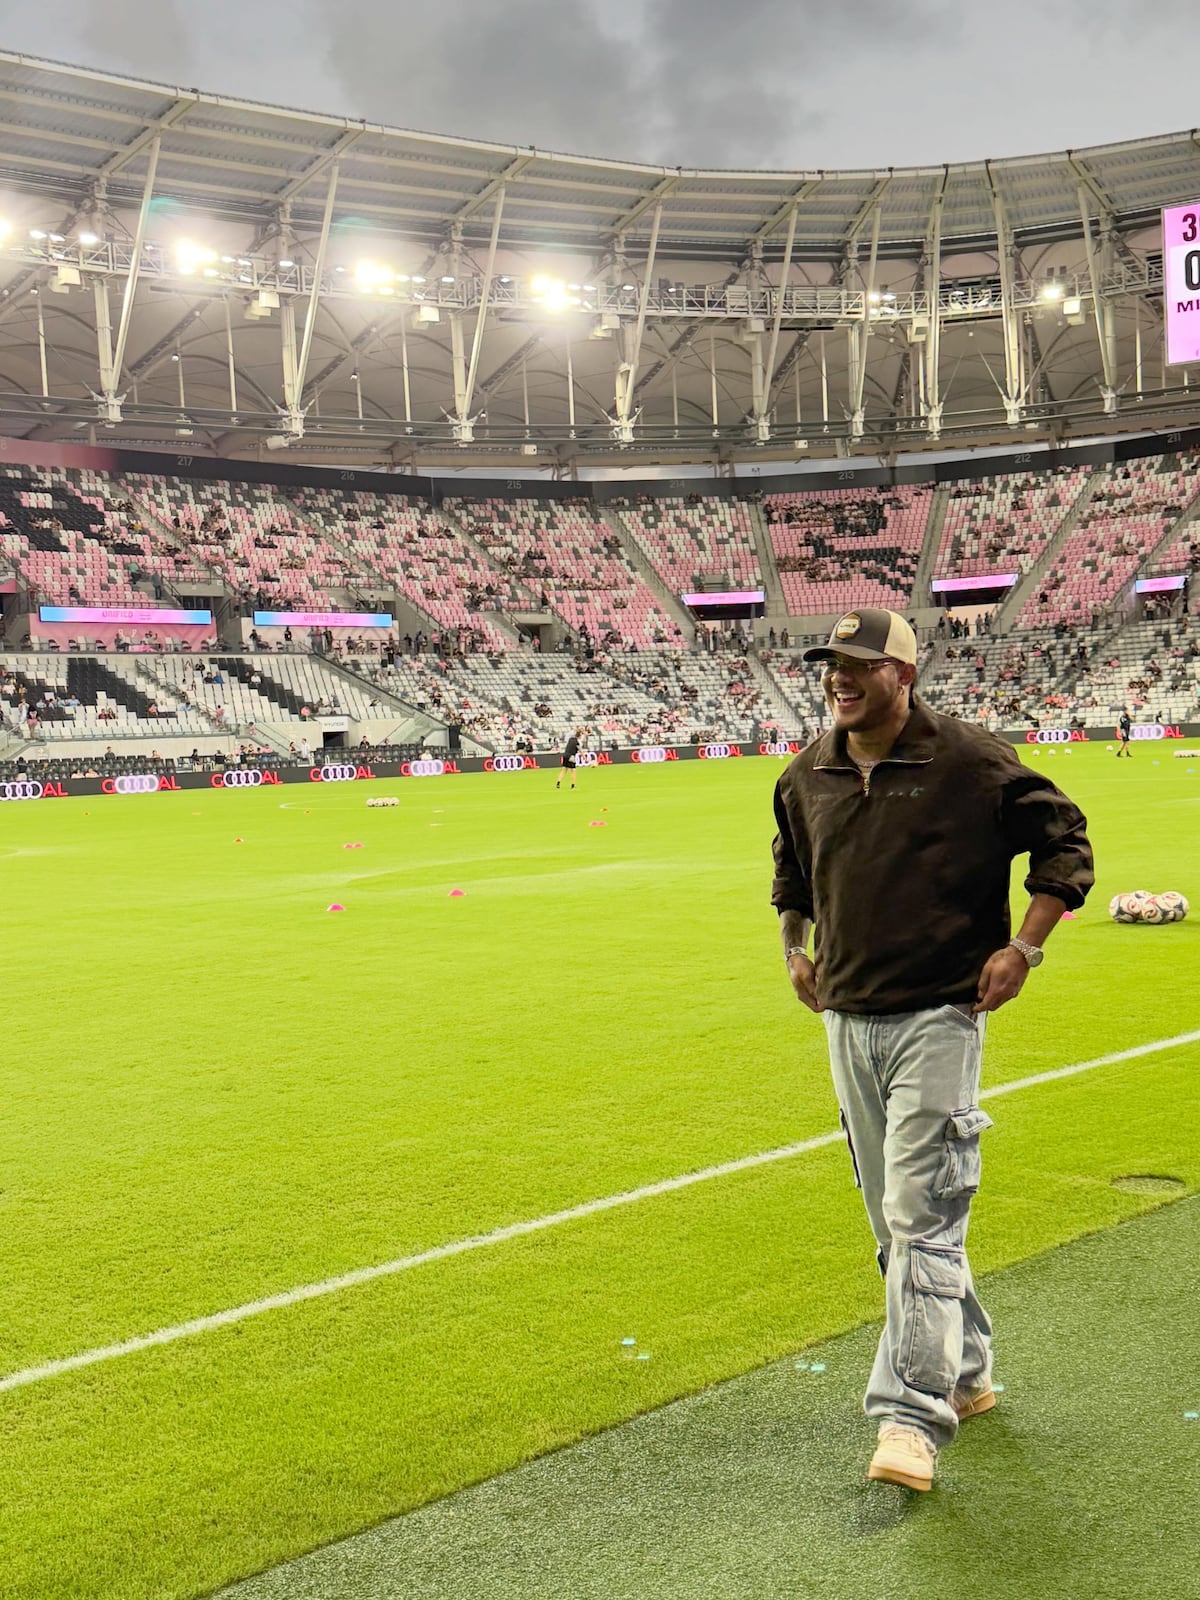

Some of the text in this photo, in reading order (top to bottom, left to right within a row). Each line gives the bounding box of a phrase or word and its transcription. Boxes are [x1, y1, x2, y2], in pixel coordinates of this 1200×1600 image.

[1167, 432, 1182, 444] 211
[177, 455, 193, 467] 217
[1014, 453, 1032, 464] 212
[340, 470, 356, 481] 216
[838, 470, 855, 481] 213
[506, 480, 522, 490] 215
[669, 479, 686, 489] 214
